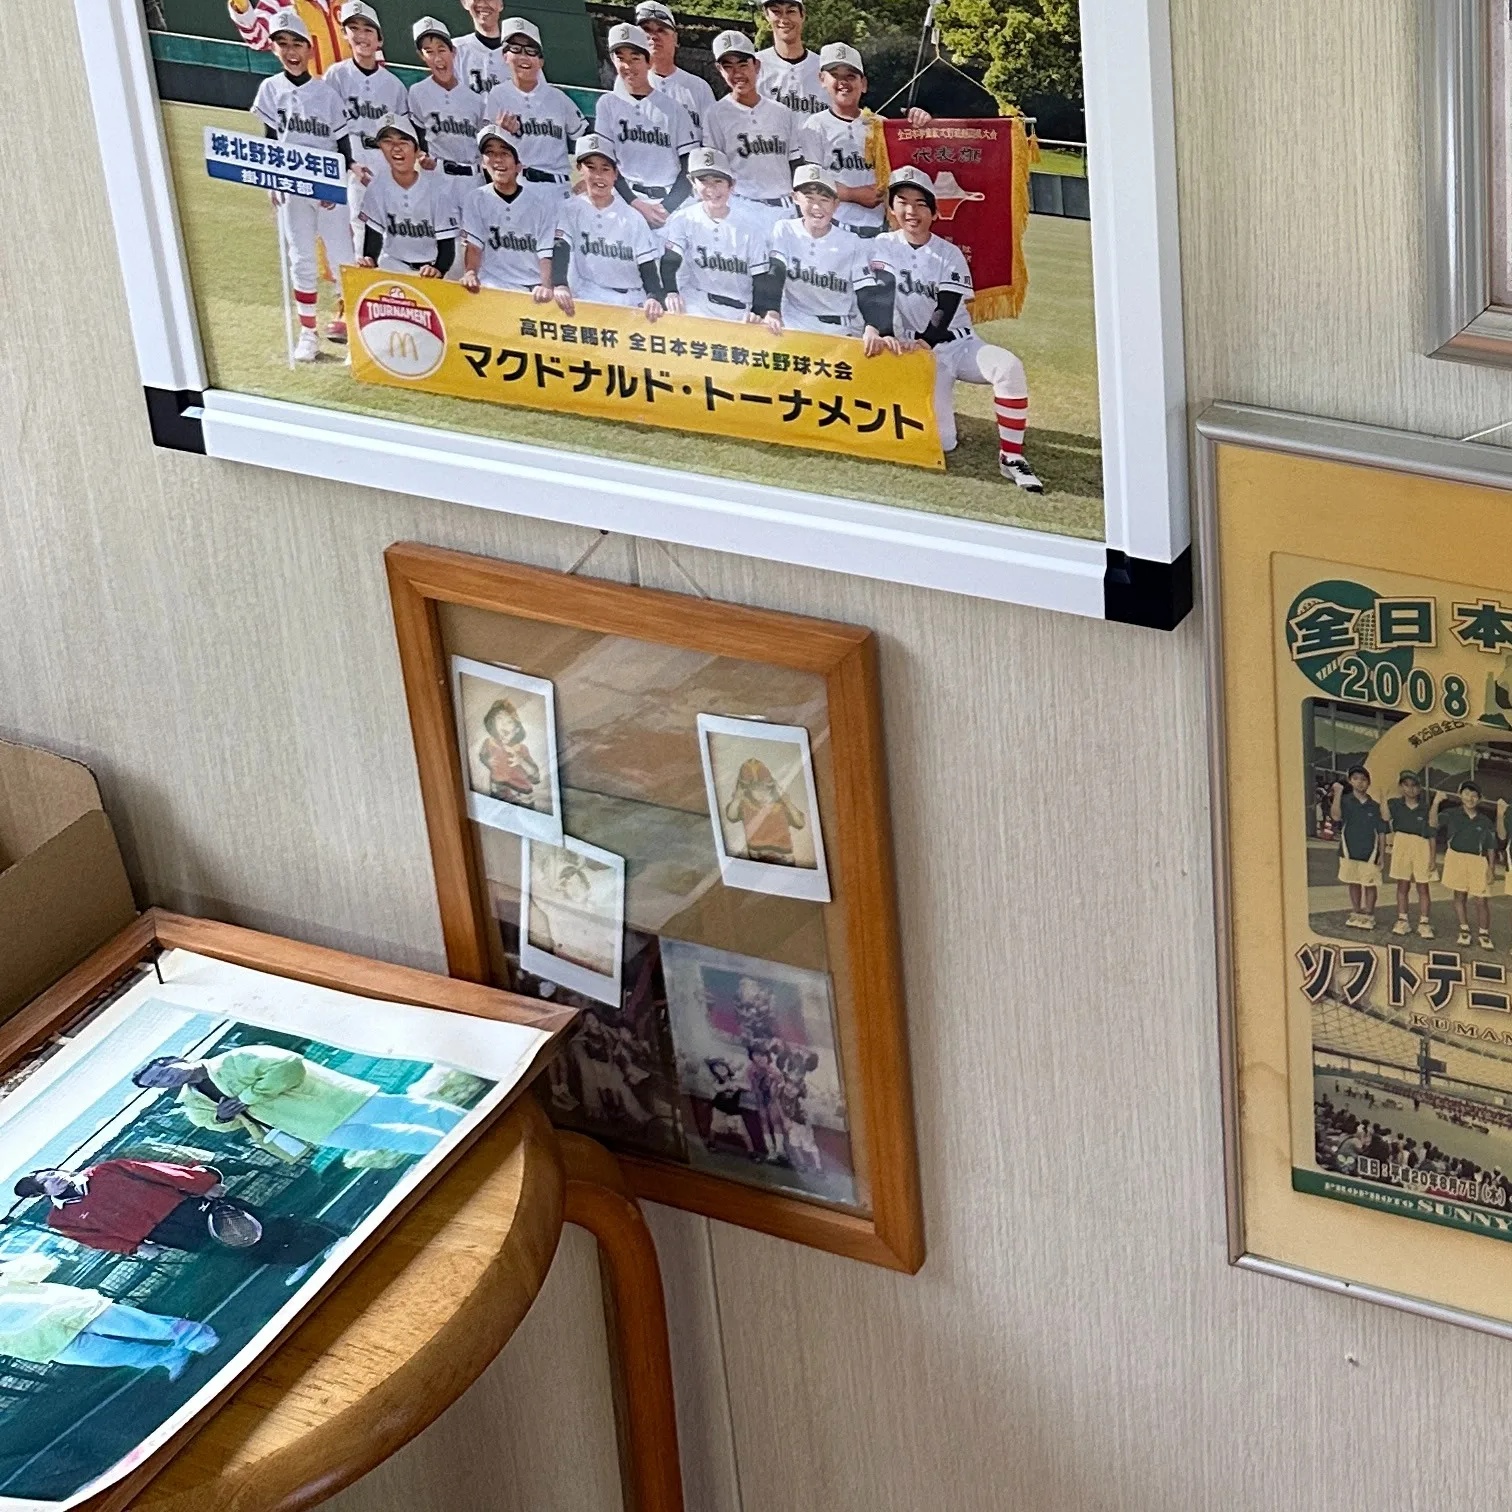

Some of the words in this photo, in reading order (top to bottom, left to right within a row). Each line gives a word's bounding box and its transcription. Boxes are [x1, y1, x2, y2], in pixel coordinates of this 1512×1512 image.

[210, 133, 341, 181] 城北野球少年団
[519, 318, 619, 349] 高円宮賜杯
[629, 332, 853, 381] 全日本学童軟式野球大会
[1339, 656, 1471, 720] 2008
